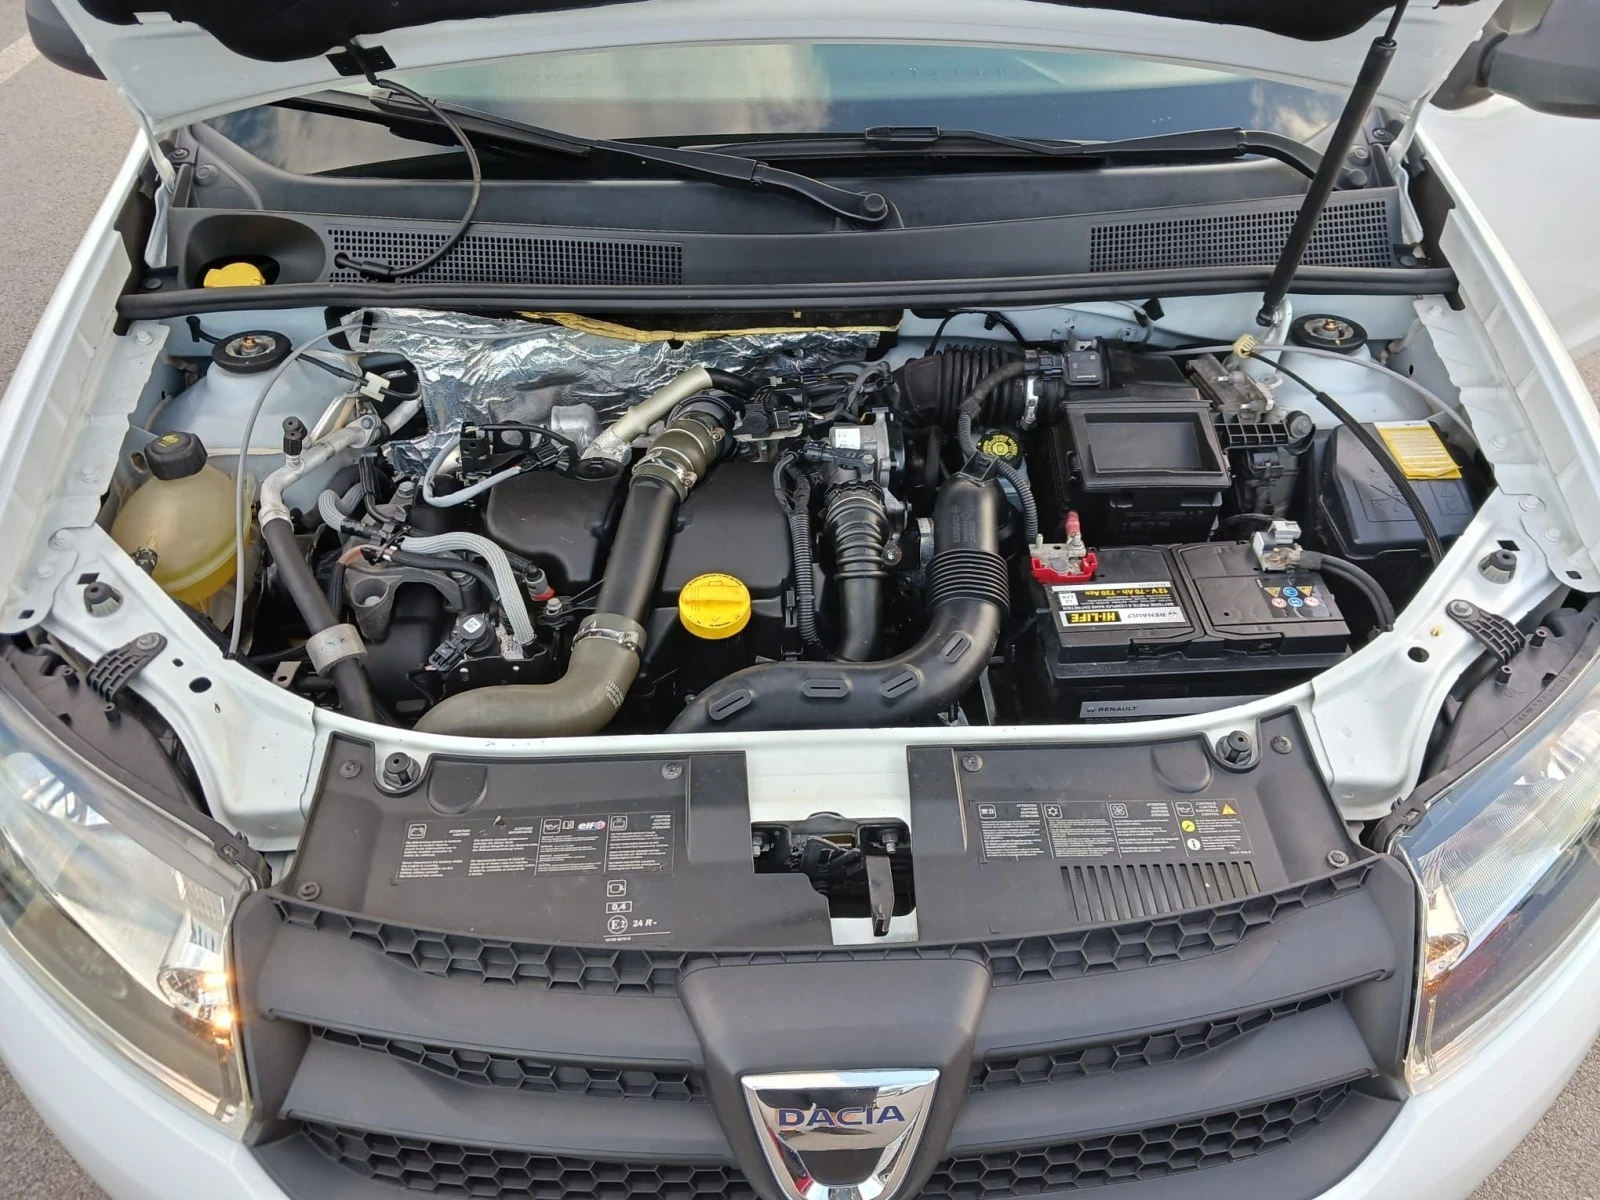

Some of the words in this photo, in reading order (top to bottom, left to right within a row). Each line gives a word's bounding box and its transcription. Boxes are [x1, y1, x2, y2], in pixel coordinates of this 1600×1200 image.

[1070, 612, 1116, 622] HI-LIFE
[578, 822, 596, 830] elf
[611, 903, 626, 912] 0,4
[611, 920, 626, 930] E2
[632, 920, 643, 928] 24
[778, 1105, 906, 1127] DACIA
